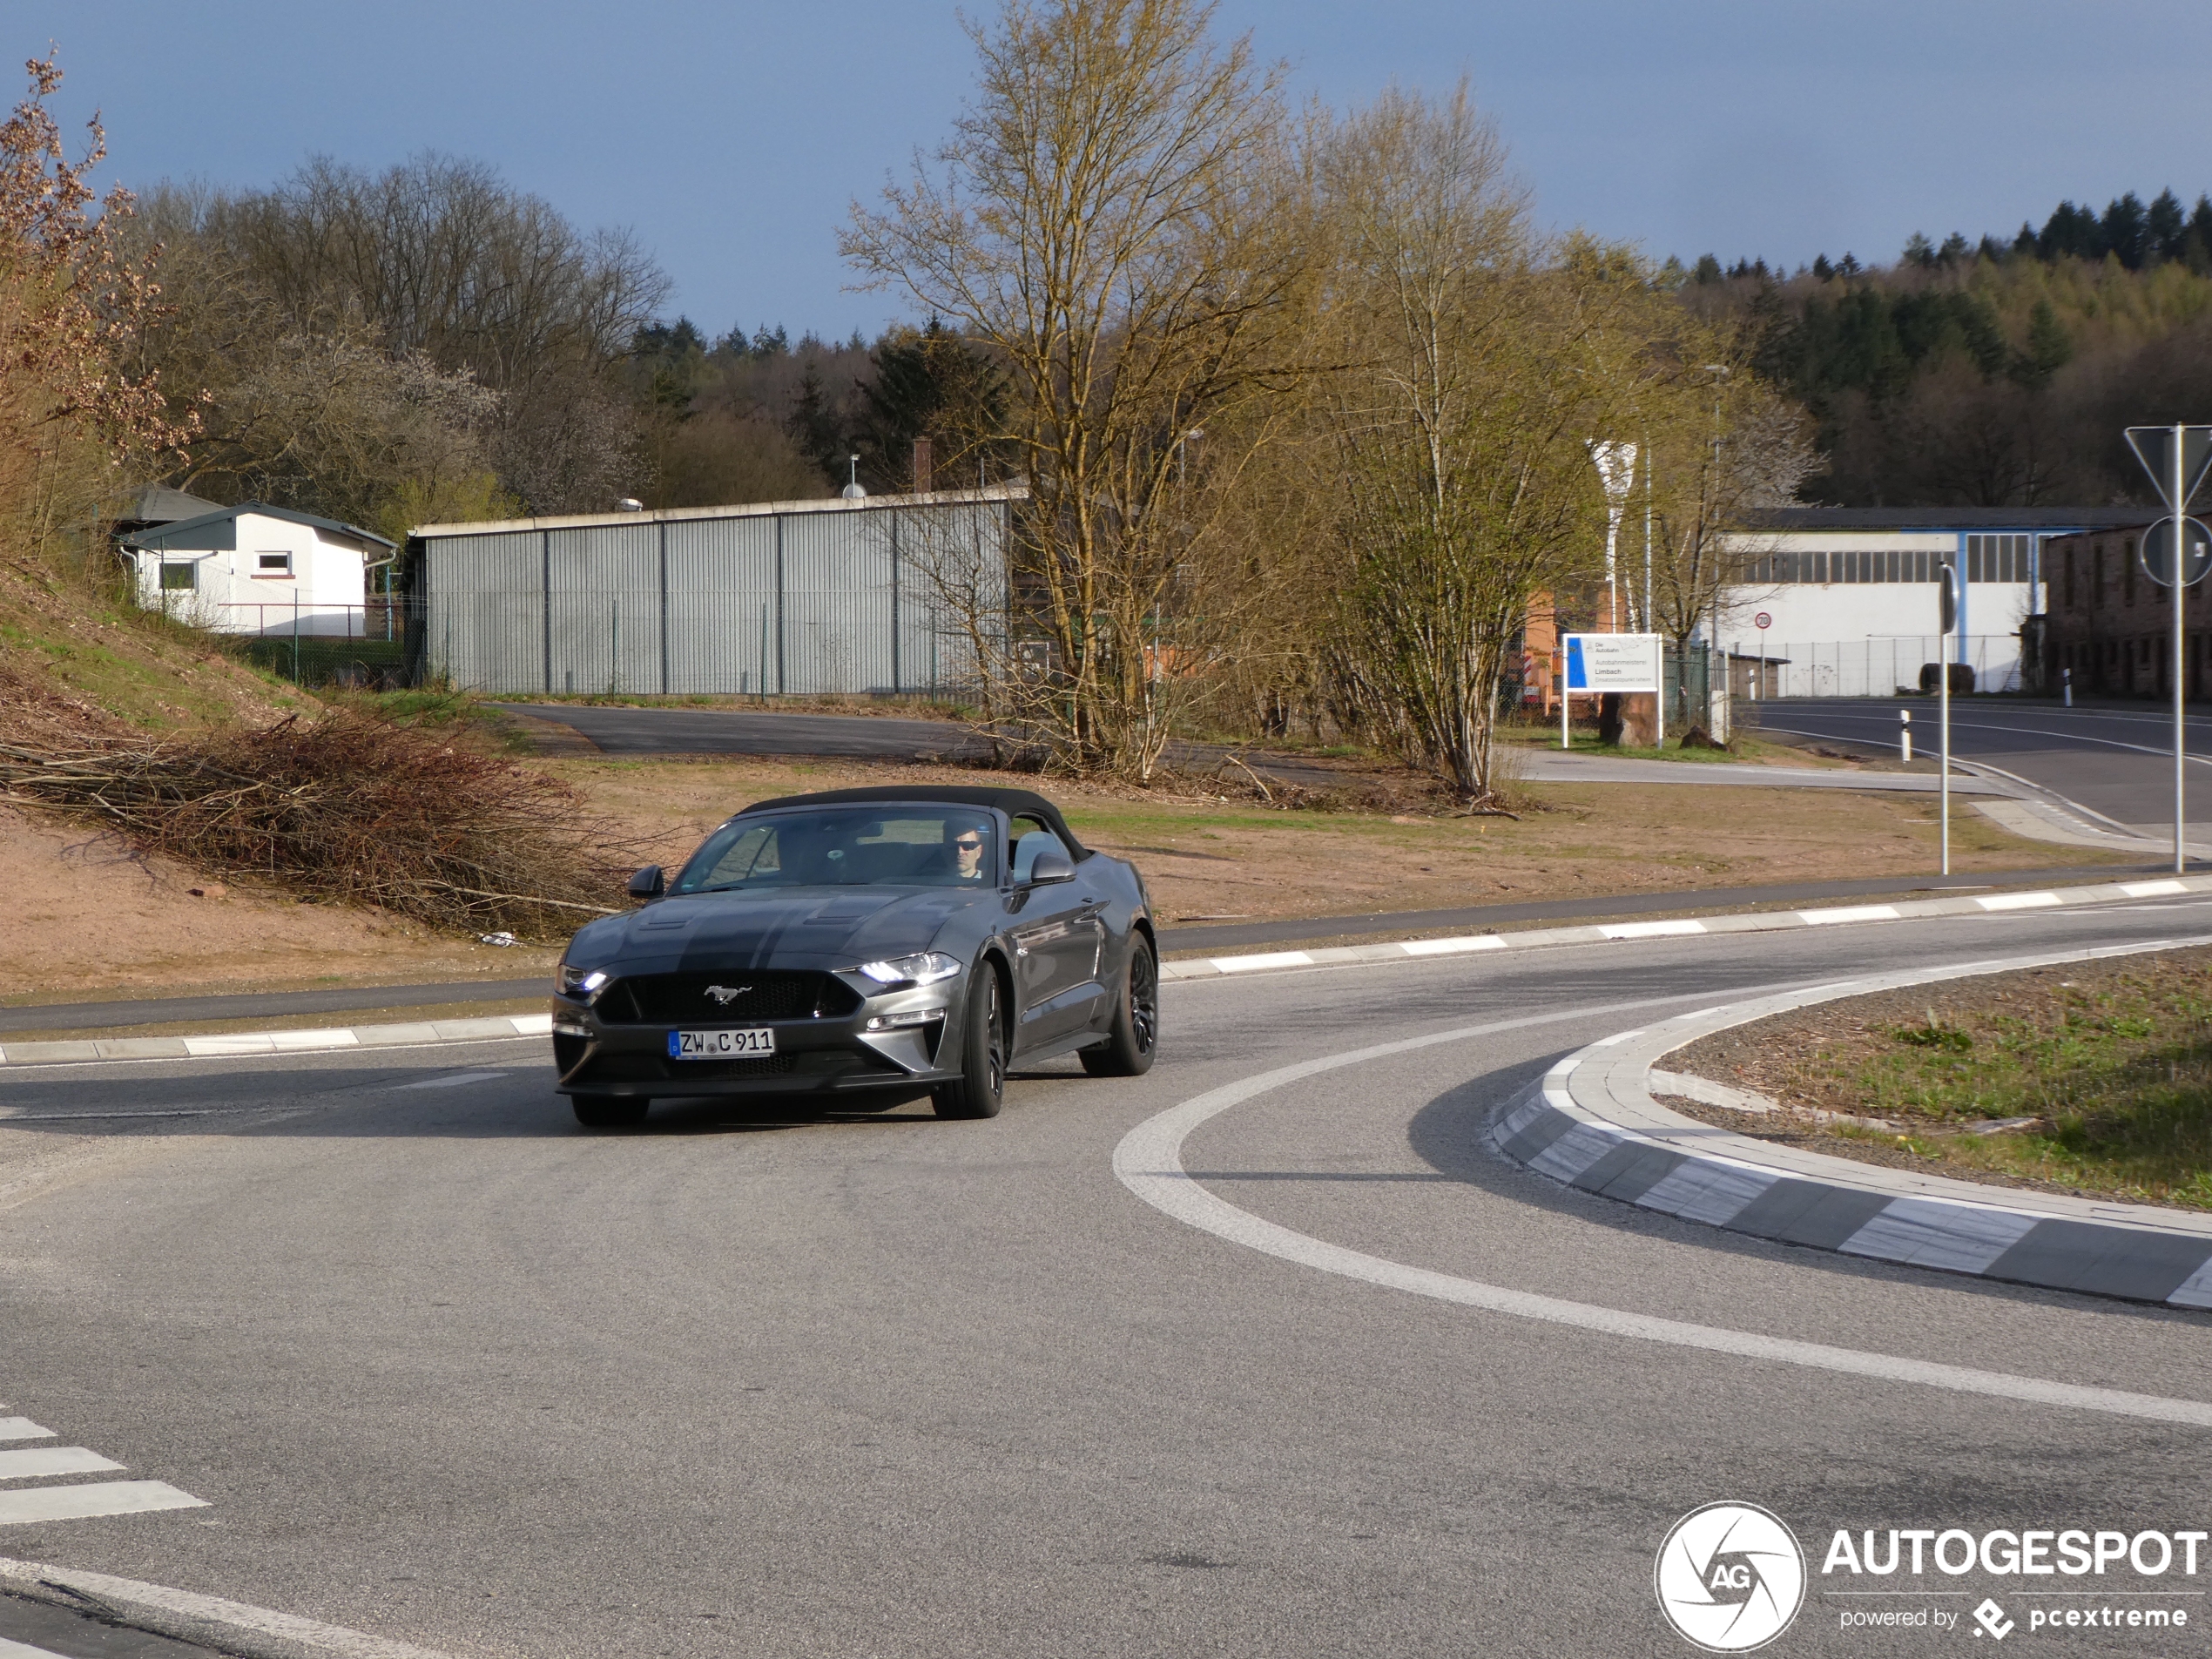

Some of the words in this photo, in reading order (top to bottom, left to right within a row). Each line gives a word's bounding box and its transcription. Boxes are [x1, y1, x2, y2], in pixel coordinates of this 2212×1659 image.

[1758, 617, 1769, 625] 70
[680, 1034, 704, 1052] ZW
[718, 1033, 731, 1051] C
[736, 1031, 772, 1051] 911
